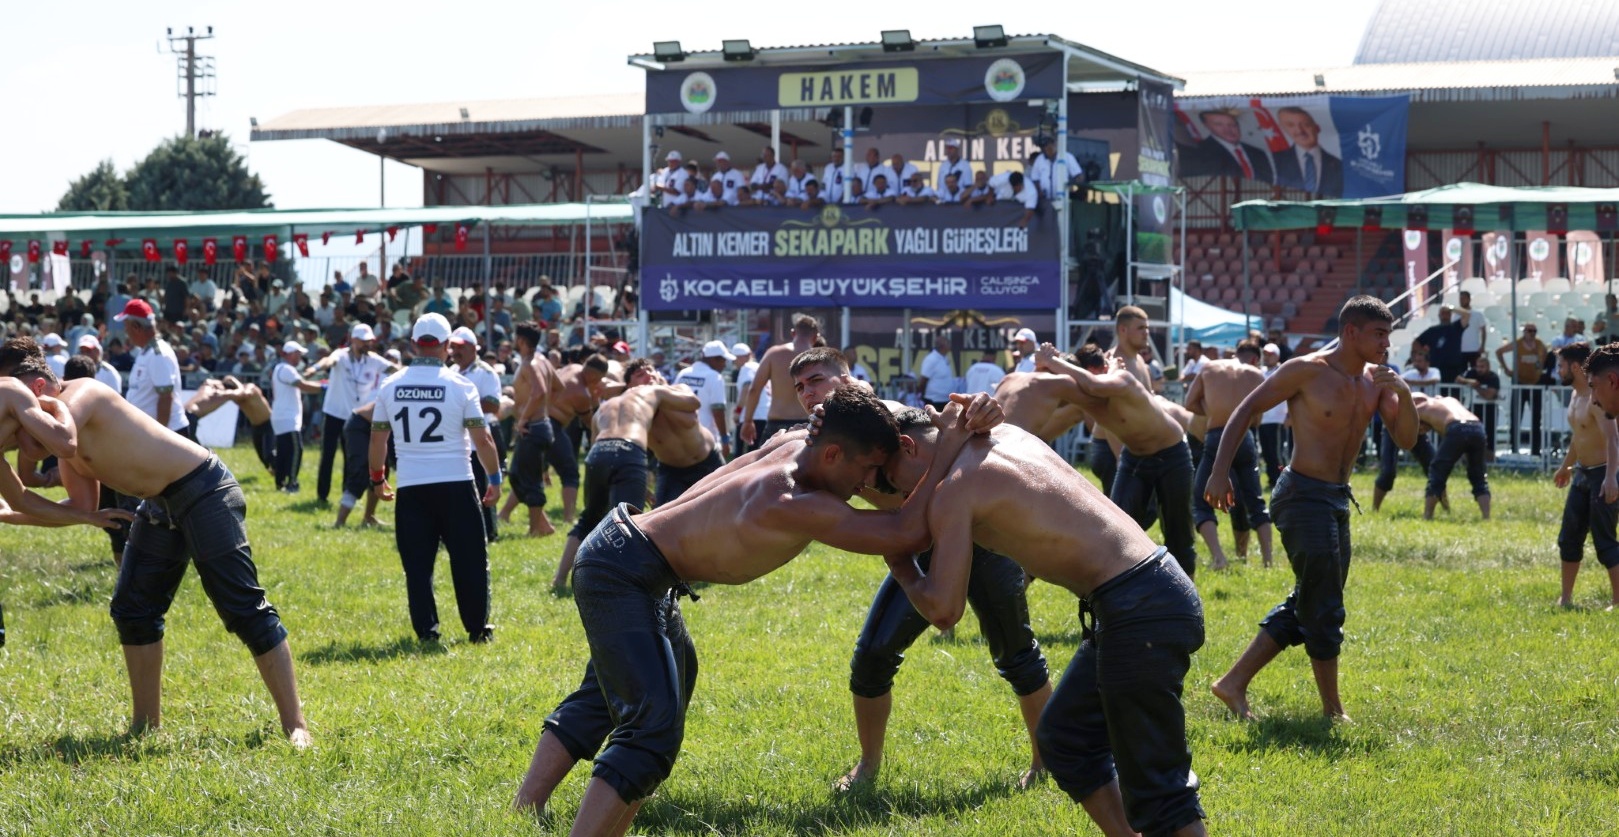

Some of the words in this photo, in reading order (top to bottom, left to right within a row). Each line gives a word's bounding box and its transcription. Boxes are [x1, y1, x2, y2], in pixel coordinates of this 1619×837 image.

[801, 73, 896, 101] HAKEM
[924, 138, 985, 161] ALIN
[996, 136, 1042, 160] KEM
[673, 232, 713, 257] ALTIN
[717, 231, 769, 256] KEMER
[774, 227, 890, 257] SEKAPARK
[894, 227, 938, 254] YAĞLI
[942, 226, 1028, 255] GÜREŞLERİ
[683, 279, 789, 296] KOCAELİ
[800, 277, 968, 298] BÜYÜKŞEHİR
[980, 285, 1028, 295] OLUYOR
[963, 328, 1016, 349] KEME
[396, 388, 443, 400] ÖZÜNLÜ
[394, 406, 444, 443] 12
